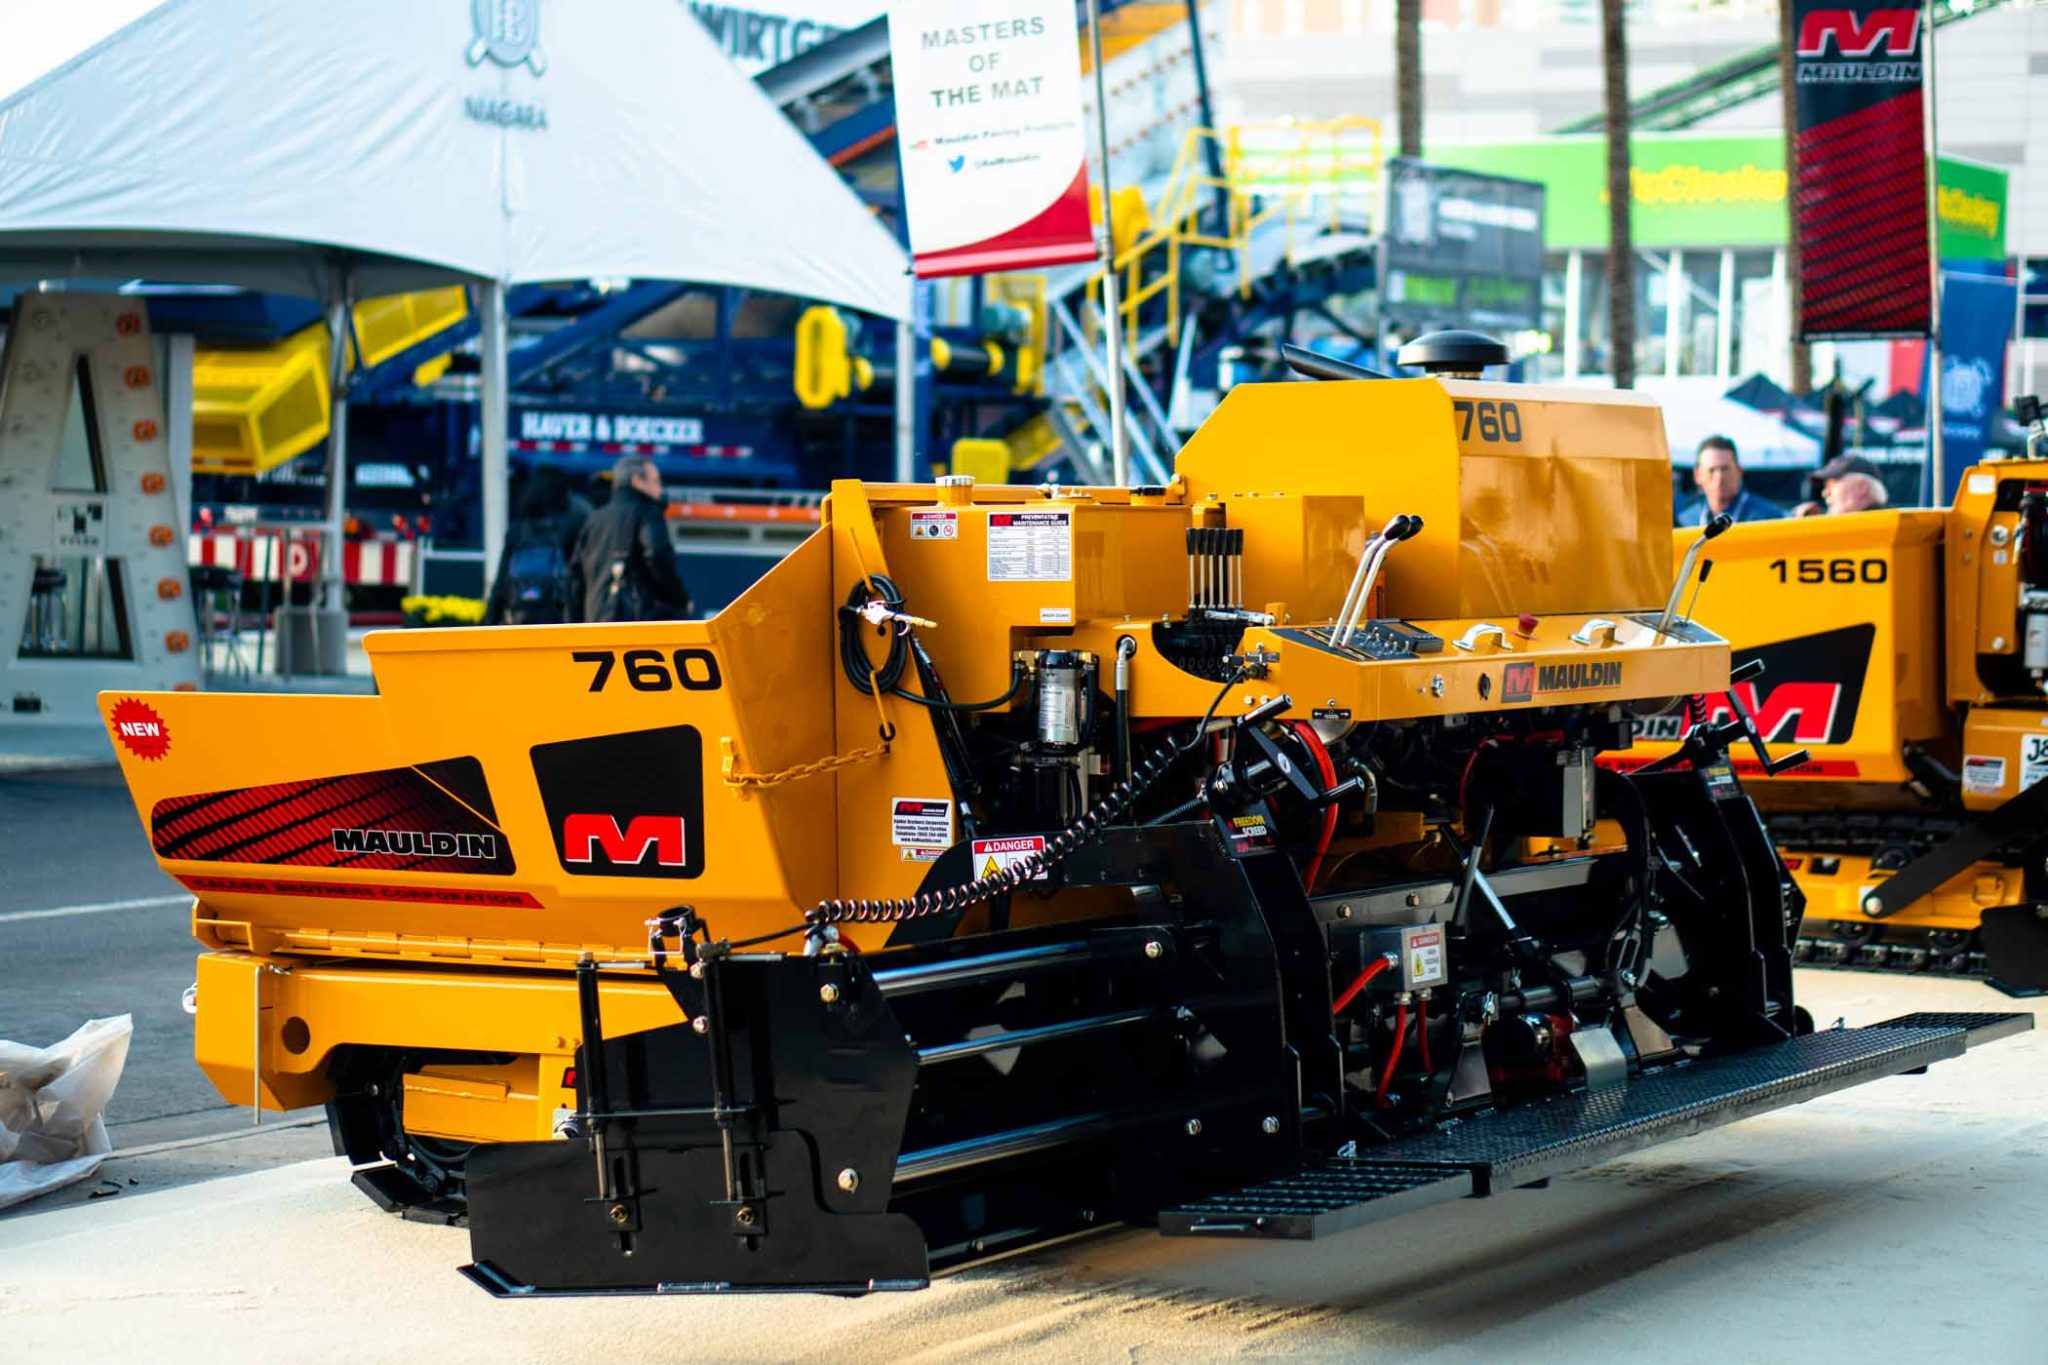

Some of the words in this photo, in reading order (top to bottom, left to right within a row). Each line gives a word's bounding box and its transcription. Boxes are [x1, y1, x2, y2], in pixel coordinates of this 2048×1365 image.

[921, 15, 1046, 49] MASTERS
[968, 52, 1000, 73] OF
[1798, 62, 1921, 84] MAULDIN
[930, 85, 982, 108] THE
[991, 76, 1044, 100] MAT
[465, 96, 548, 131] NIAGARA
[1453, 401, 1522, 442] 760
[1769, 558, 1888, 584] 1560
[571, 648, 722, 693] 760
[1538, 661, 1622, 691] MAULDIN
[120, 722, 160, 737] NEW
[1232, 815, 1266, 828] FREEDOM
[1242, 825, 1268, 837] SCREED
[332, 829, 496, 859] MAULDIN
[993, 840, 1035, 852] DANGER
[273, 883, 376, 899] BROTHERS
[380, 887, 523, 905] CORPORATION
